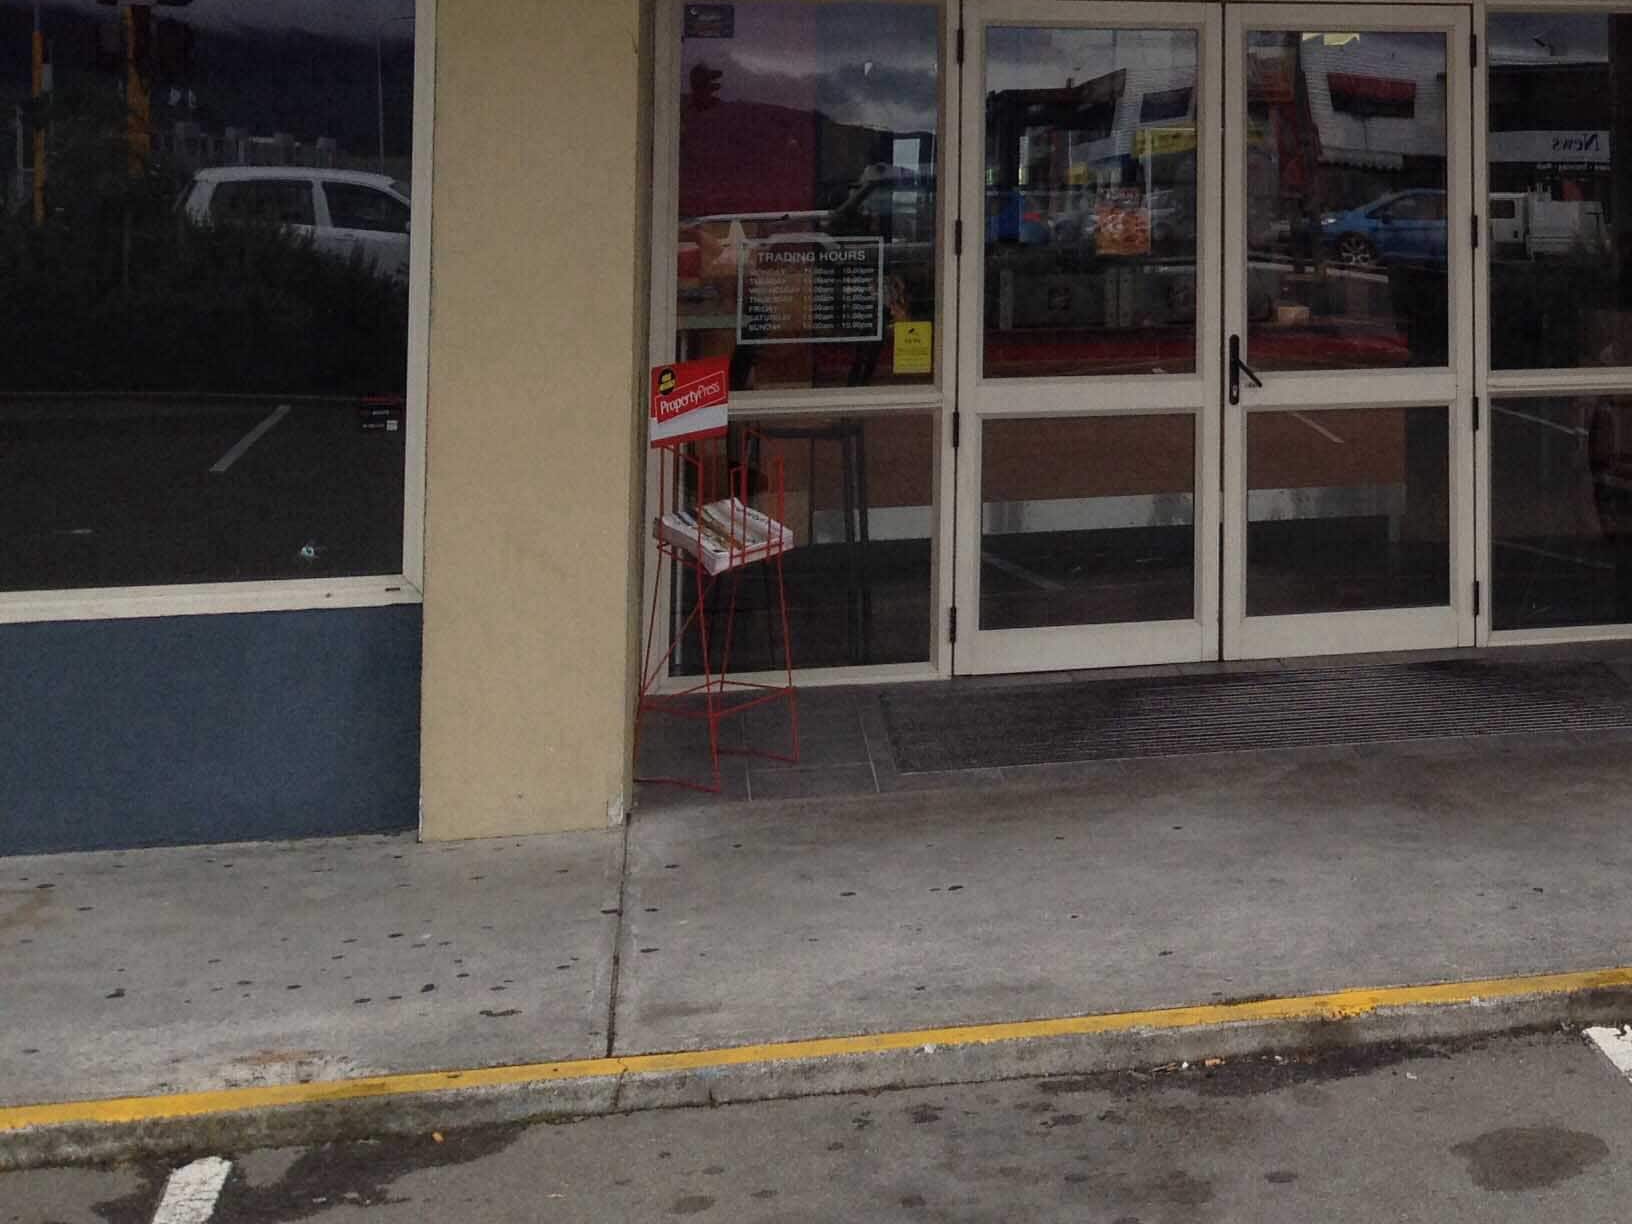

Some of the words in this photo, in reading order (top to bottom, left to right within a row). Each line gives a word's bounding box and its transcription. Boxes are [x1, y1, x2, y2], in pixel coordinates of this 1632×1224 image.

[757, 251, 816, 264] TRADING
[819, 249, 866, 262] HOURS
[660, 380, 721, 416] PropertyPress
